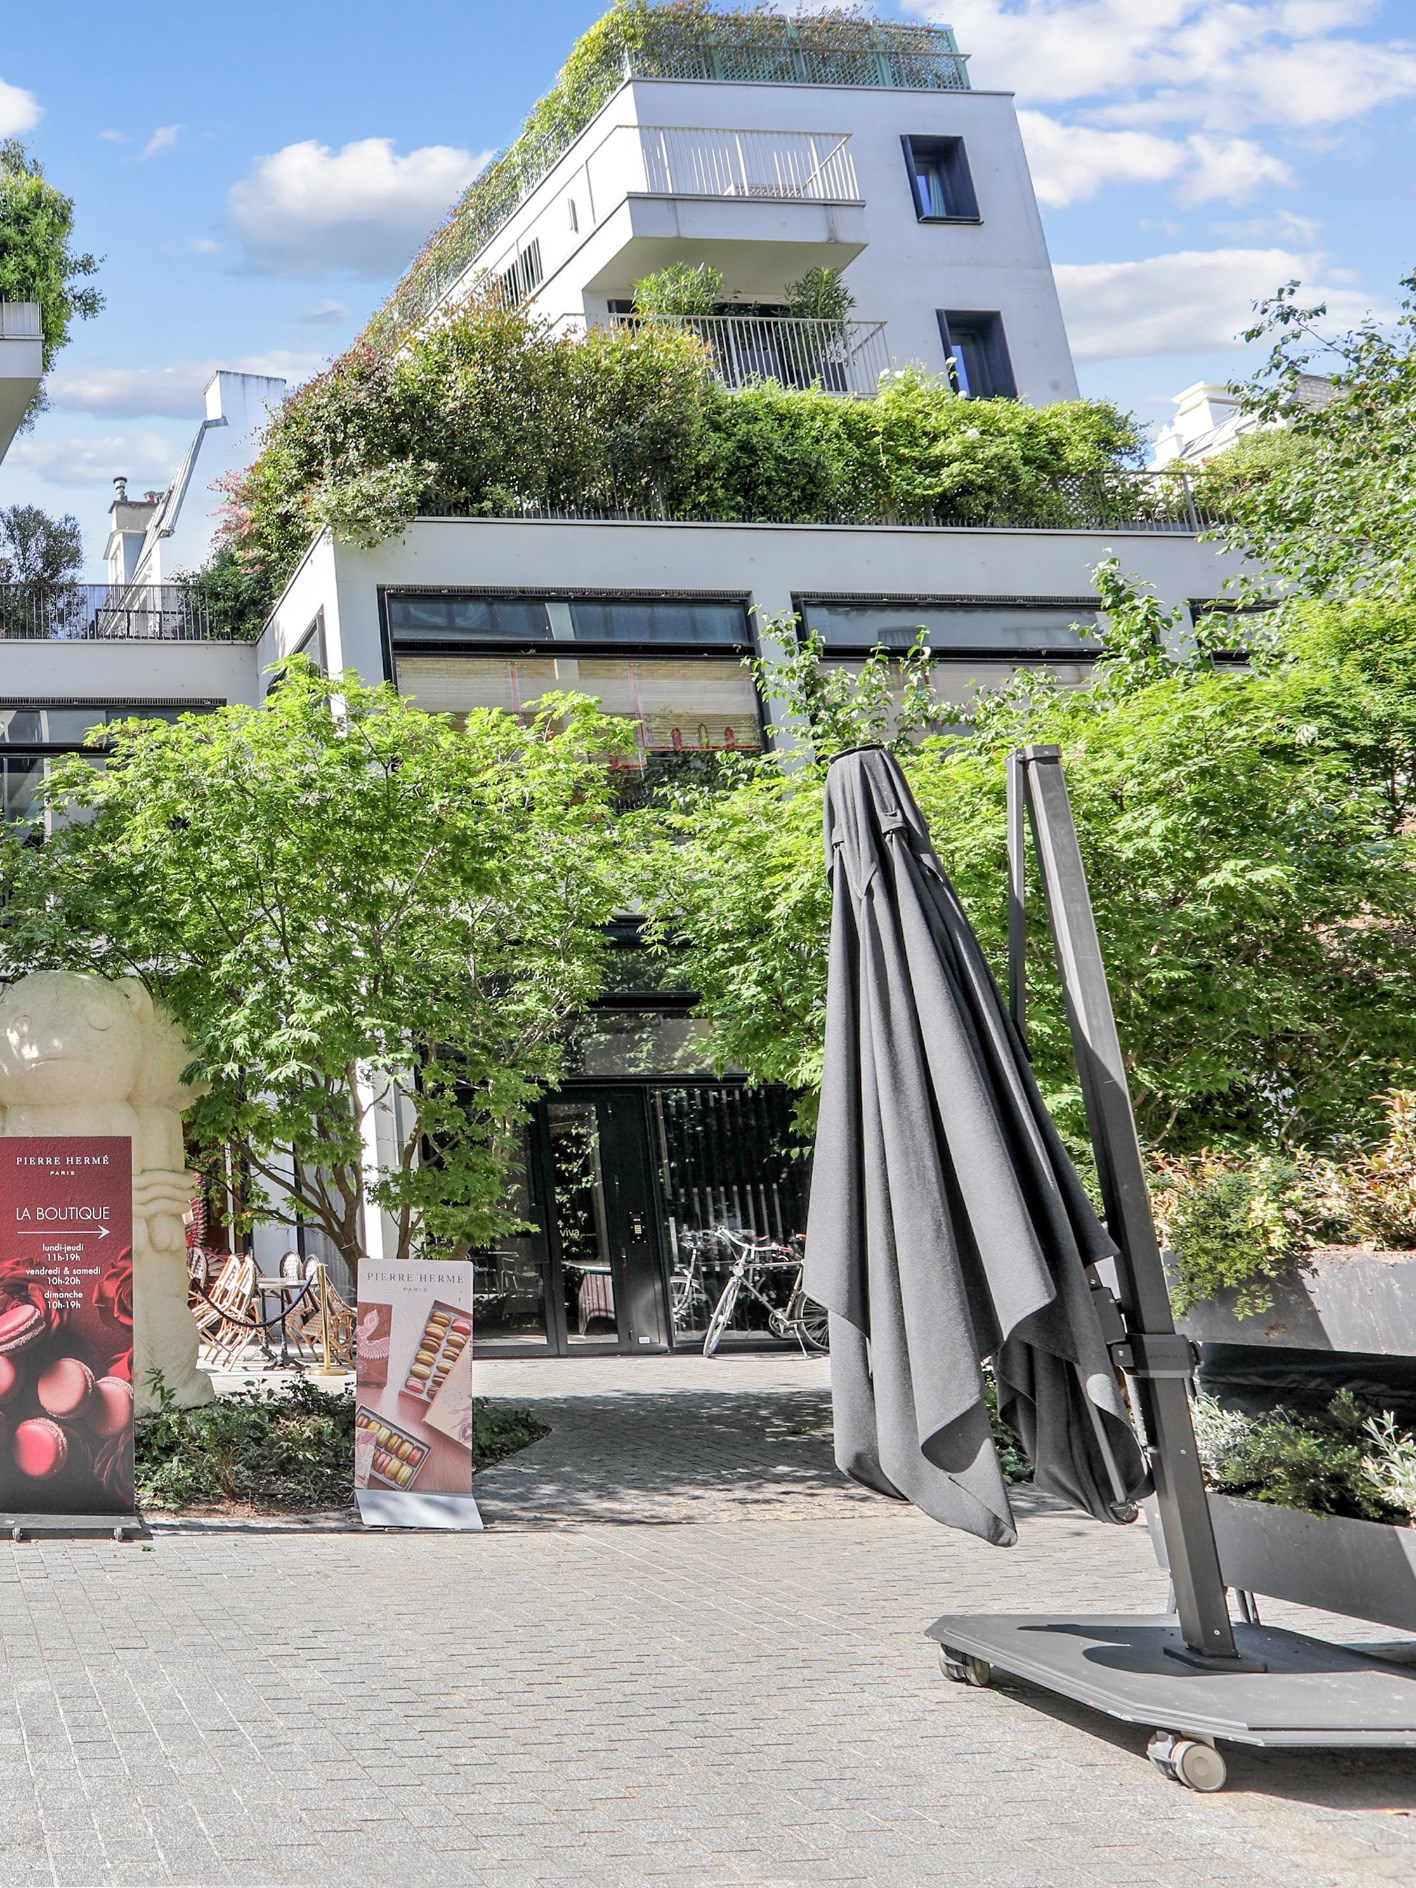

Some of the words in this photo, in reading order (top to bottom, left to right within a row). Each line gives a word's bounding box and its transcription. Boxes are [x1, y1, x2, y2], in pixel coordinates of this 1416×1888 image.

[16, 1156, 61, 1166] PIERRE
[66, 1154, 110, 1165] HERMÉ
[16, 1207, 32, 1221] LA
[36, 1206, 110, 1221] BOUTIQUE
[42, 1243, 84, 1253] lundi-jeudi
[47, 1253, 81, 1262] 11h-19h
[25, 1266, 61, 1275] vendredi
[63, 1266, 71, 1275] &
[72, 1265, 102, 1275] samedi
[47, 1276, 81, 1286] 10h-20h
[367, 1272, 414, 1282] PIERRE
[419, 1272, 465, 1284] HERMÉ
[44, 1289, 84, 1299] dimanche
[47, 1300, 81, 1310] 10h-19h
